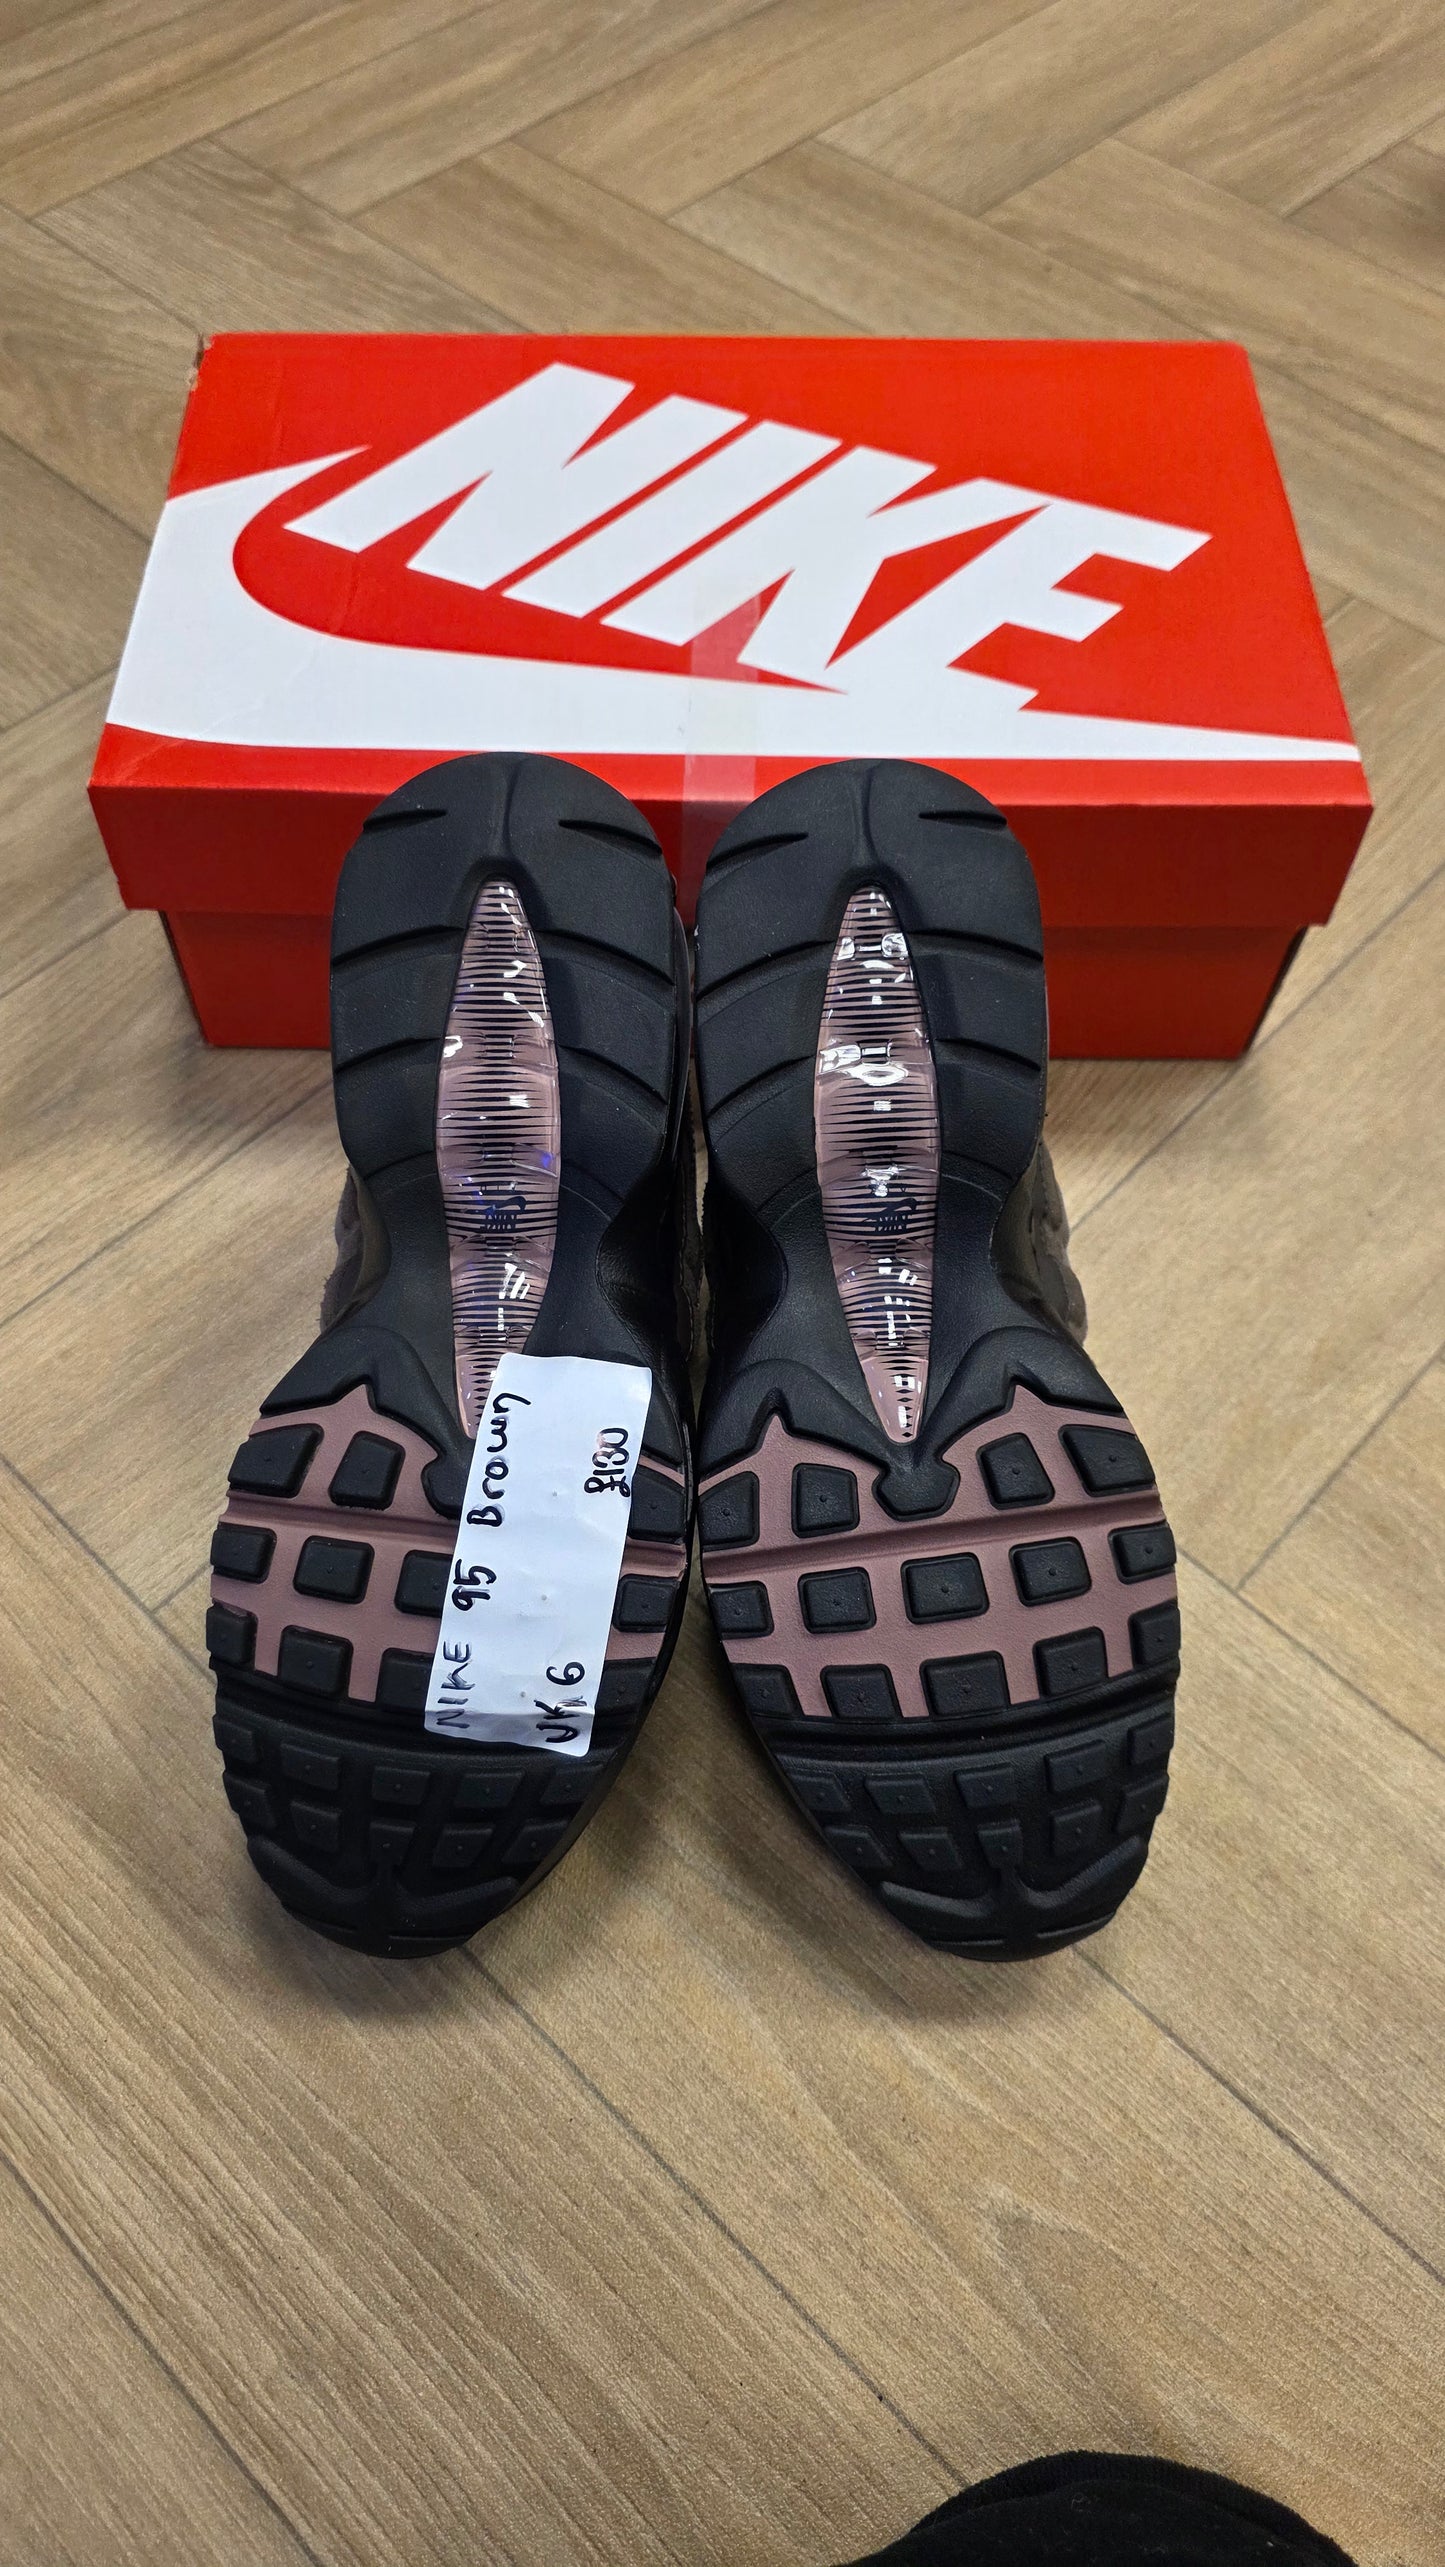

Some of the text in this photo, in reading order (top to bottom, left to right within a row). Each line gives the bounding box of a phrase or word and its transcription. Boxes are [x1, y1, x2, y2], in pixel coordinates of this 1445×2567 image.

[283, 361, 1212, 711] NIKE
[435, 1391, 532, 1729] NIKE 95 Brown
[583, 1426, 632, 1498] £130
[534, 1660, 588, 1743] UK 6
